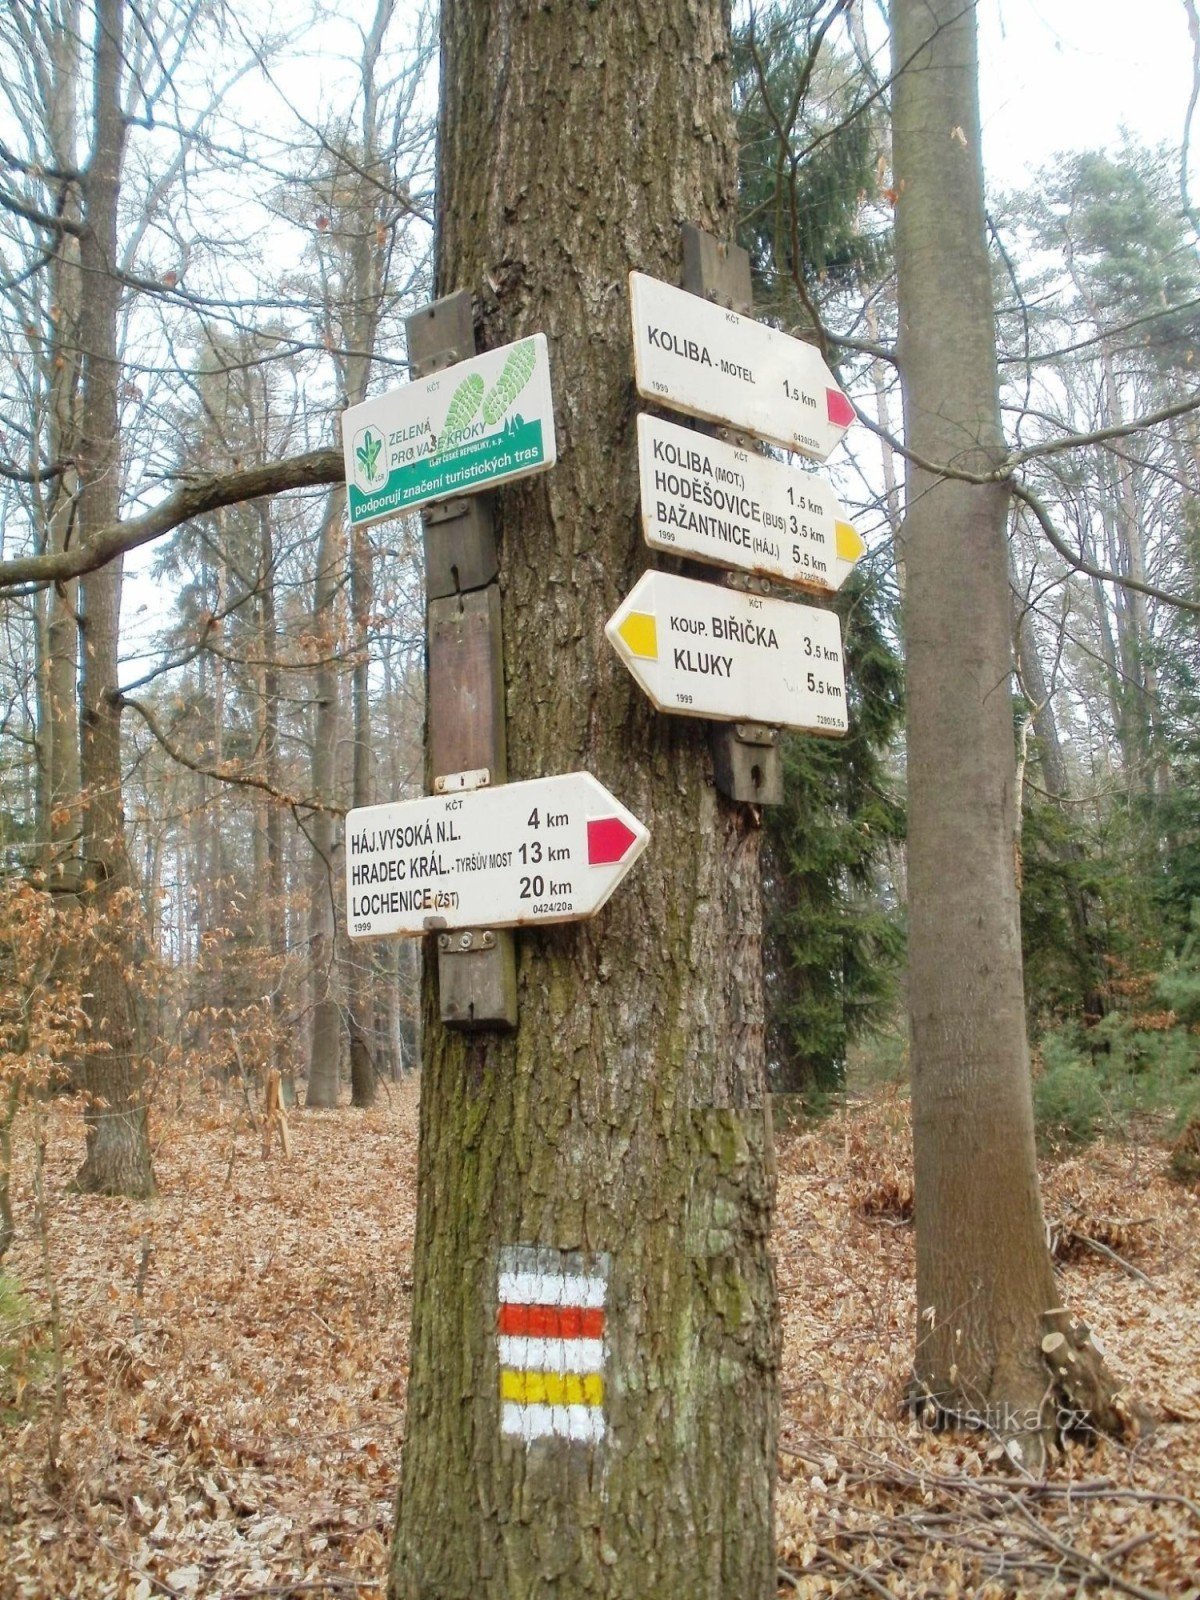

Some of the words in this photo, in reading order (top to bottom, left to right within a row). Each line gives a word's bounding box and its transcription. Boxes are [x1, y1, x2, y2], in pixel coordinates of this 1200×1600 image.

[725, 312, 740, 325] KČT
[647, 325, 712, 367] KOLIBA
[720, 358, 756, 384] MOTEL
[782, 379, 800, 401] 1.5
[801, 391, 817, 409] km
[651, 380, 669, 393] 1999
[389, 417, 431, 446] ZELENÁ
[391, 447, 414, 465] PRO
[446, 422, 487, 444] KROKY
[733, 450, 748, 463] KČT
[355, 488, 401, 517] podporují
[403, 473, 443, 499] značení
[445, 453, 511, 485] turistických
[514, 446, 538, 462] tras
[653, 438, 713, 478] KOLIBA
[715, 466, 745, 491] (MOT.)
[787, 486, 806, 509] 1.5
[808, 498, 824, 515] km
[655, 470, 761, 522] HODĚŠOVICE
[762, 511, 787, 534] (BUS)
[789, 515, 808, 538] 3.5
[810, 527, 825, 544] km
[657, 501, 751, 549] BAŽANTNICE
[752, 536, 780, 561] (HÁJ.)
[792, 544, 810, 567] 5.5
[811, 555, 827, 573] km
[658, 529, 675, 542] 1999
[748, 598, 763, 610] KČT
[670, 615, 708, 637] KOUP.
[711, 615, 779, 650] BIŘIČKA
[803, 636, 822, 659] 3.5
[823, 646, 839, 662] km
[673, 647, 733, 678] KLUKY
[807, 672, 824, 694] 5.5
[826, 682, 842, 698] km
[676, 693, 693, 704] 1999
[445, 799, 463, 811] KČT
[527, 807, 540, 829] 4
[546, 812, 569, 828] km
[352, 859, 406, 886] HRADEC
[489, 851, 513, 869] MOST
[518, 841, 543, 865] 13
[548, 846, 571, 862] km
[353, 888, 432, 917] LOCHENICE
[434, 890, 460, 911] (ŽST)
[519, 875, 545, 899] 20
[549, 880, 572, 896] km
[532, 901, 573, 914] 0424/20a
[354, 921, 372, 933] 1999
